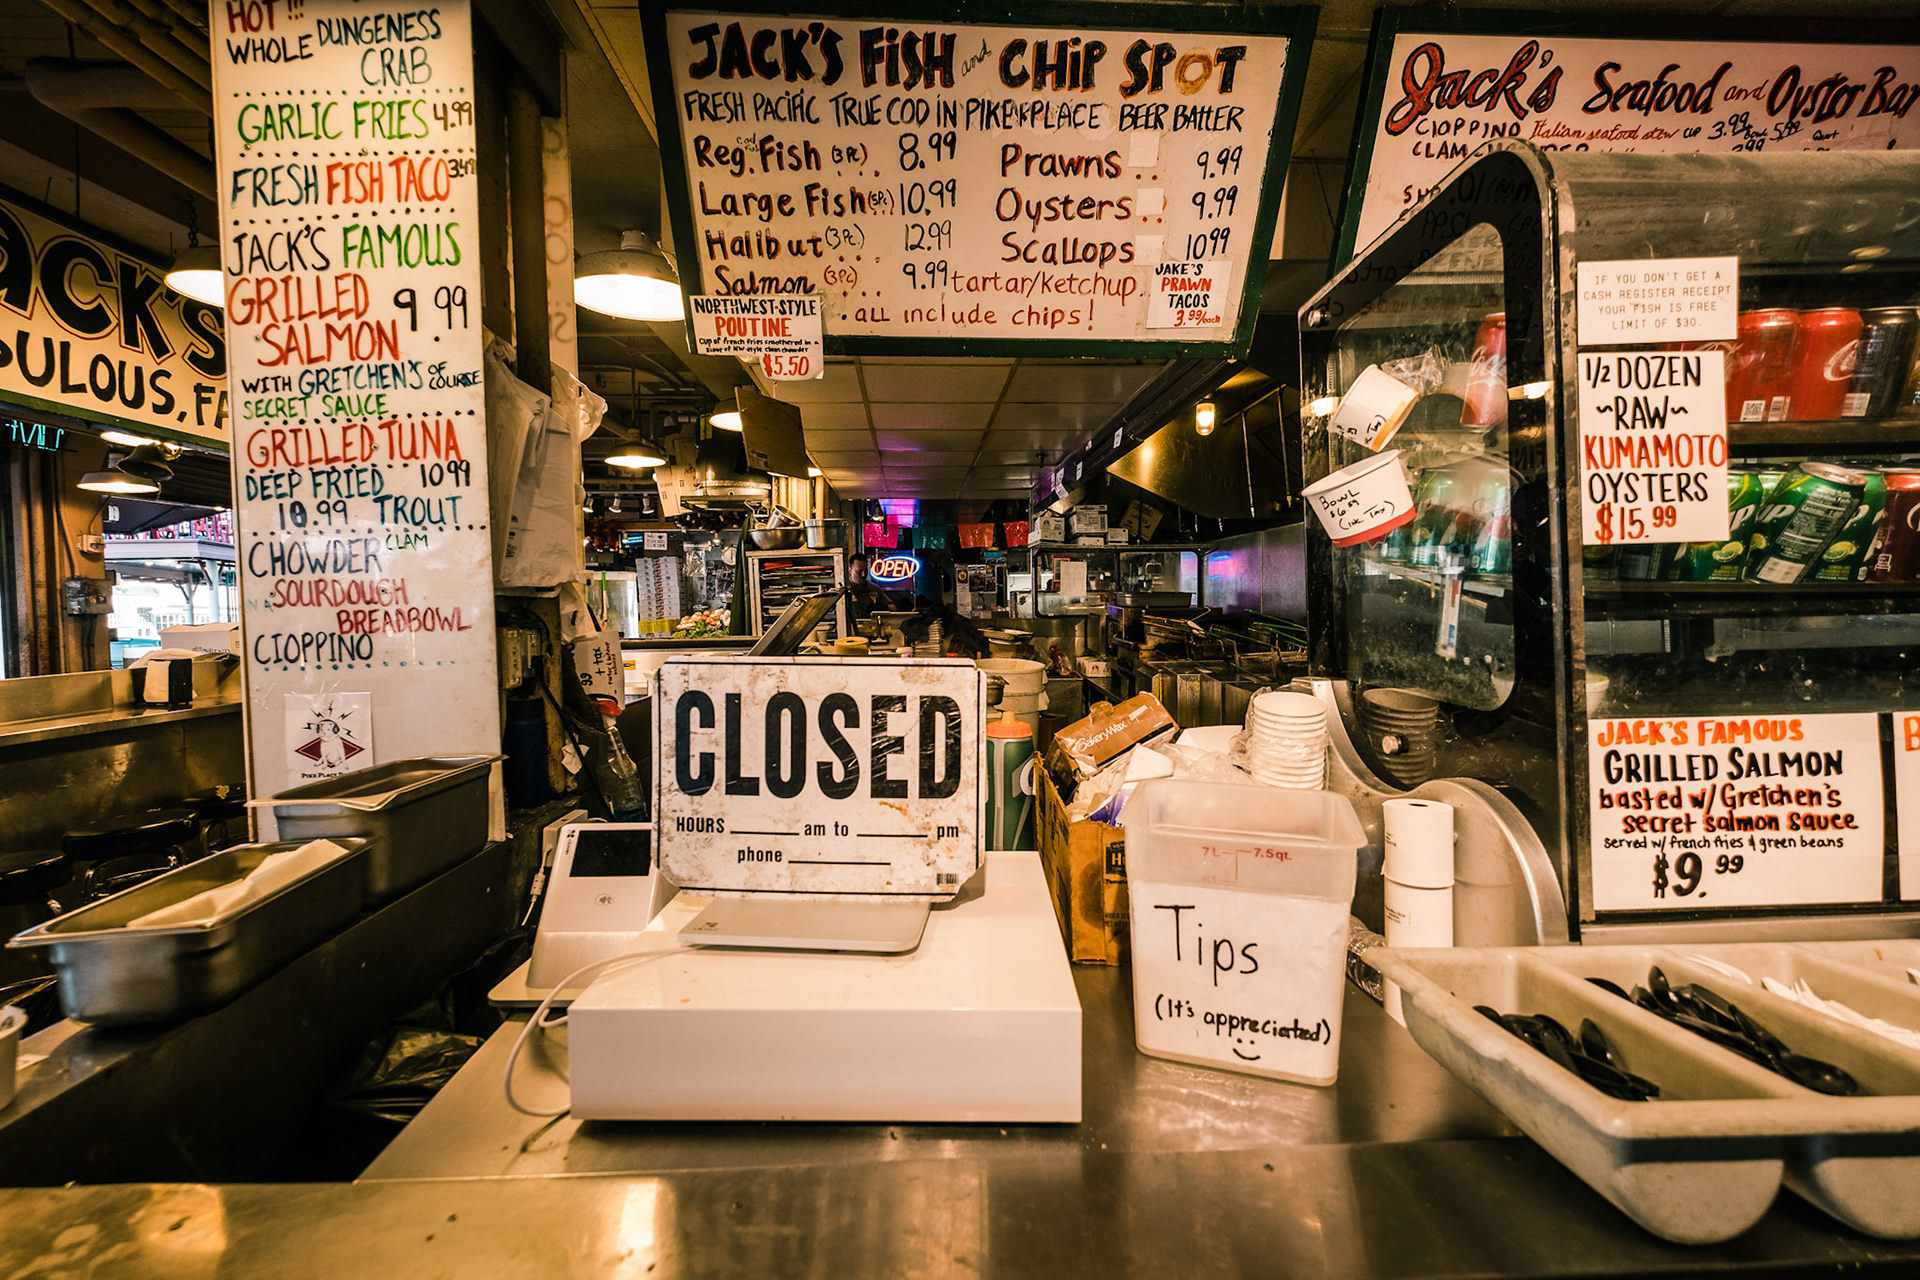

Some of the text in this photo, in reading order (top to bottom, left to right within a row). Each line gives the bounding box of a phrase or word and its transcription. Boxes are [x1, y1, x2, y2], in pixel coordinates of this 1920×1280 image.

[226, 9, 442, 65] WHOLE DUNGENESS
[360, 46, 433, 87] CRAB
[687, 22, 844, 87] JACK'S
[961, 38, 993, 77] and
[1119, 39, 1248, 100] SPOT
[1384, 39, 1920, 137] Jack's Seafood and Oyster Bar
[237, 99, 473, 144] GARLIC FRIES 4.99
[683, 89, 1246, 132] FRESH TRUE COD PIKE PLACE BEER BATTER
[1415, 117, 1522, 138] CIOPPINO
[1529, 118, 1587, 141] Italian
[1585, 123, 1642, 141] seafood
[758, 134, 822, 173] Fish
[898, 131, 957, 171] 8.99
[1000, 142, 1123, 179] Prawns
[1197, 145, 1243, 180] 9.99
[1412, 140, 1469, 160] CLAM
[231, 163, 319, 209] FRESH
[326, 160, 384, 205] FISH
[388, 155, 450, 203] TACO
[699, 178, 1239, 233] Large Fish 10.99 Oysters 9.99
[228, 222, 462, 276] JACK'S FAMOUS
[904, 219, 952, 251] 12.99
[1001, 230, 1136, 270] Scallops
[714, 264, 817, 297] Salmon
[902, 259, 949, 290] 9.99
[1155, 263, 1205, 277] JAKE'S
[1160, 277, 1213, 293] PRAWN
[1595, 270, 1721, 285] IF YOU DON'T GET A
[227, 273, 370, 326] GRILLED
[1167, 293, 1211, 310] TACOS
[1583, 285, 1731, 301] CASH REGISTER RECEIPT
[1598, 301, 1717, 316] YOUR FISH IS FREE
[714, 316, 793, 337] POUTINE
[903, 298, 1095, 332] include chips!
[1612, 317, 1703, 330] LIMIT OF $30.
[257, 318, 400, 367] SALMON
[699, 337, 713, 348] Cup
[723, 336, 745, 345] french
[746, 338, 764, 346] fries
[0, 330, 187, 422] ULOUS,
[241, 376, 292, 394] WITH
[298, 360, 423, 396] GRETCHEN'S
[428, 361, 448, 376] OF
[762, 353, 810, 378] $5.50
[1586, 355, 1701, 389] 1/2 DOZEN
[243, 393, 389, 420] SECRET SAUCE
[247, 418, 462, 469] GRILLED TUNA
[1584, 433, 1728, 470] KUMAMOTO
[245, 467, 384, 501] DEEP FRIED
[1588, 472, 1709, 504] OYSTERS
[278, 494, 463, 530] 10.99 TROUT
[248, 533, 429, 578] CHOWDER CLAM
[871, 558, 916, 579] OPEN
[272, 578, 409, 608] SOURDOUGH
[336, 606, 472, 635] BREADBOWL
[254, 631, 373, 665] CIOPPINO
[675, 689, 962, 800] CLOSED
[1597, 718, 1805, 747] JACK'S FAMOUS
[1603, 746, 1843, 785] GRILLED SALMON
[1599, 782, 1843, 814] basted w/ Gretchen's
[676, 816, 960, 841] HOURS am to pm
[1622, 812, 1698, 834] secret
[1703, 810, 1780, 833] salmon
[737, 846, 783, 865] phone
[1603, 836, 1647, 849] served
[1650, 834, 1667, 854] w/
[1669, 835, 1711, 850] french
[1714, 835, 1744, 849] fries
[1759, 836, 1797, 853] green
[1800, 835, 1844, 849] beans
[1153, 904, 1259, 987] Tips
[1154, 993, 1332, 1046] (It's appreciated)
